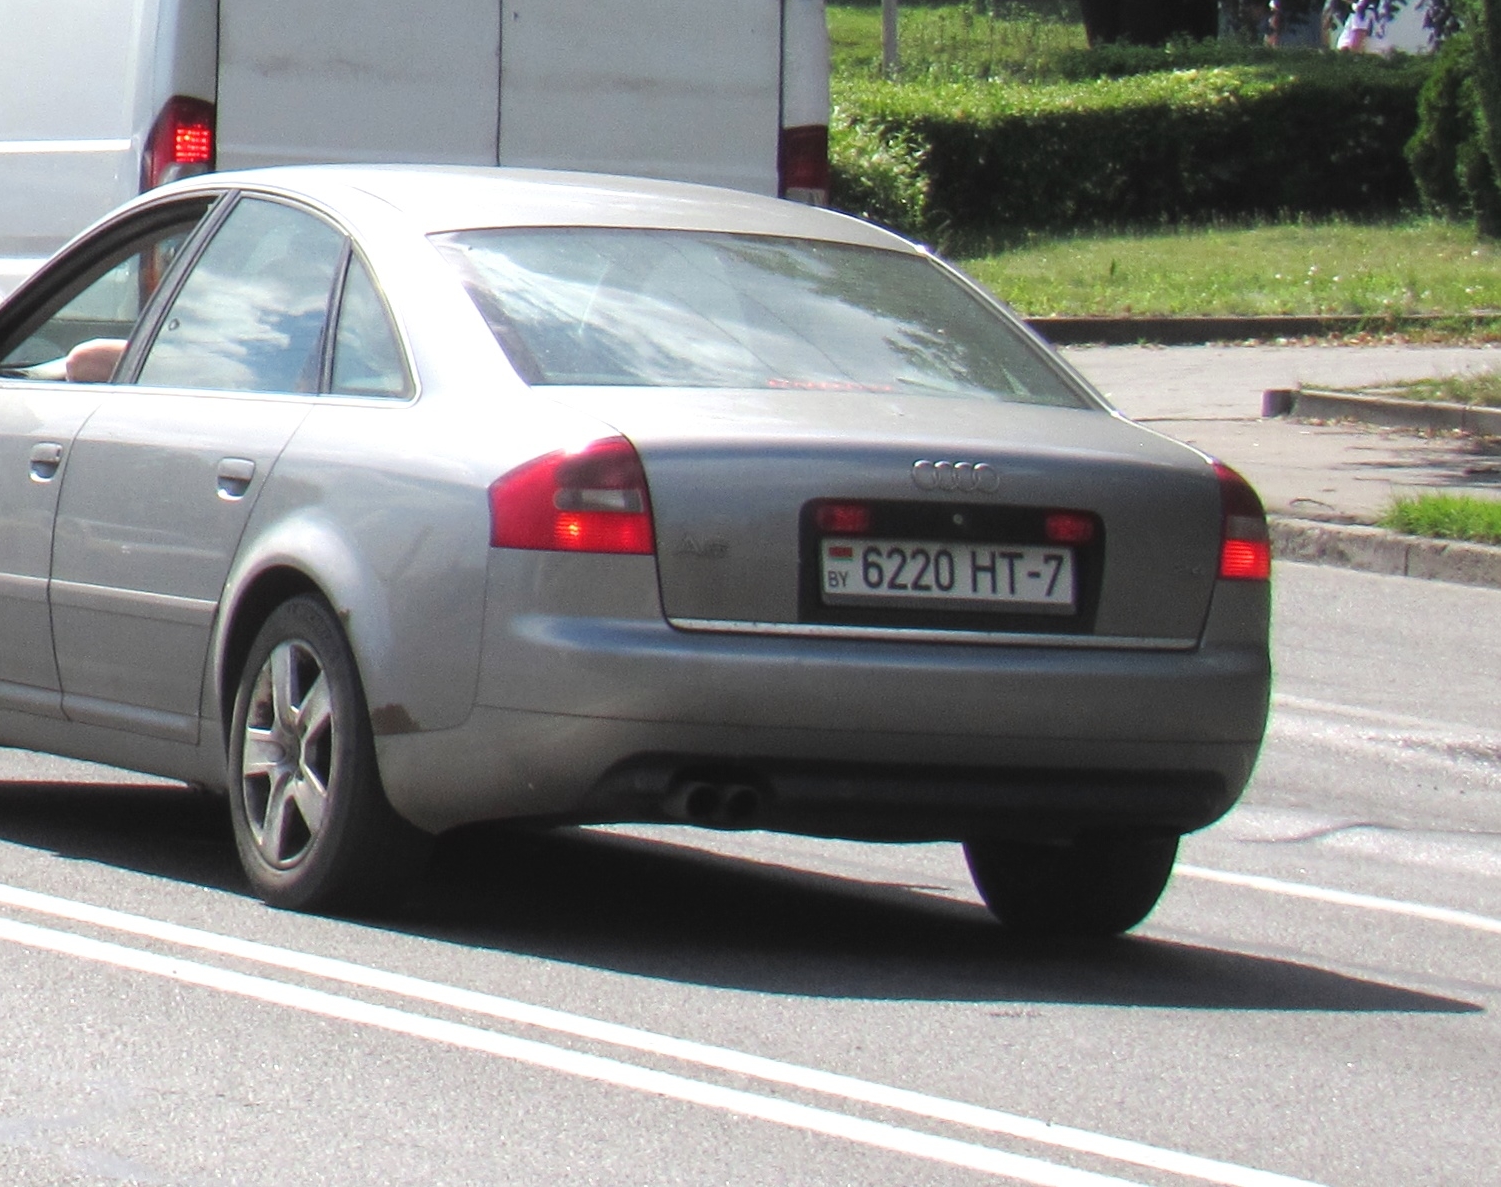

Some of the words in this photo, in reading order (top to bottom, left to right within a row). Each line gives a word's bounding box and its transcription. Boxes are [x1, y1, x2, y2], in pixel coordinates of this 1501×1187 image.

[827, 569, 848, 588] BY
[861, 545, 955, 592] 6220
[970, 549, 1065, 598] HT-7
